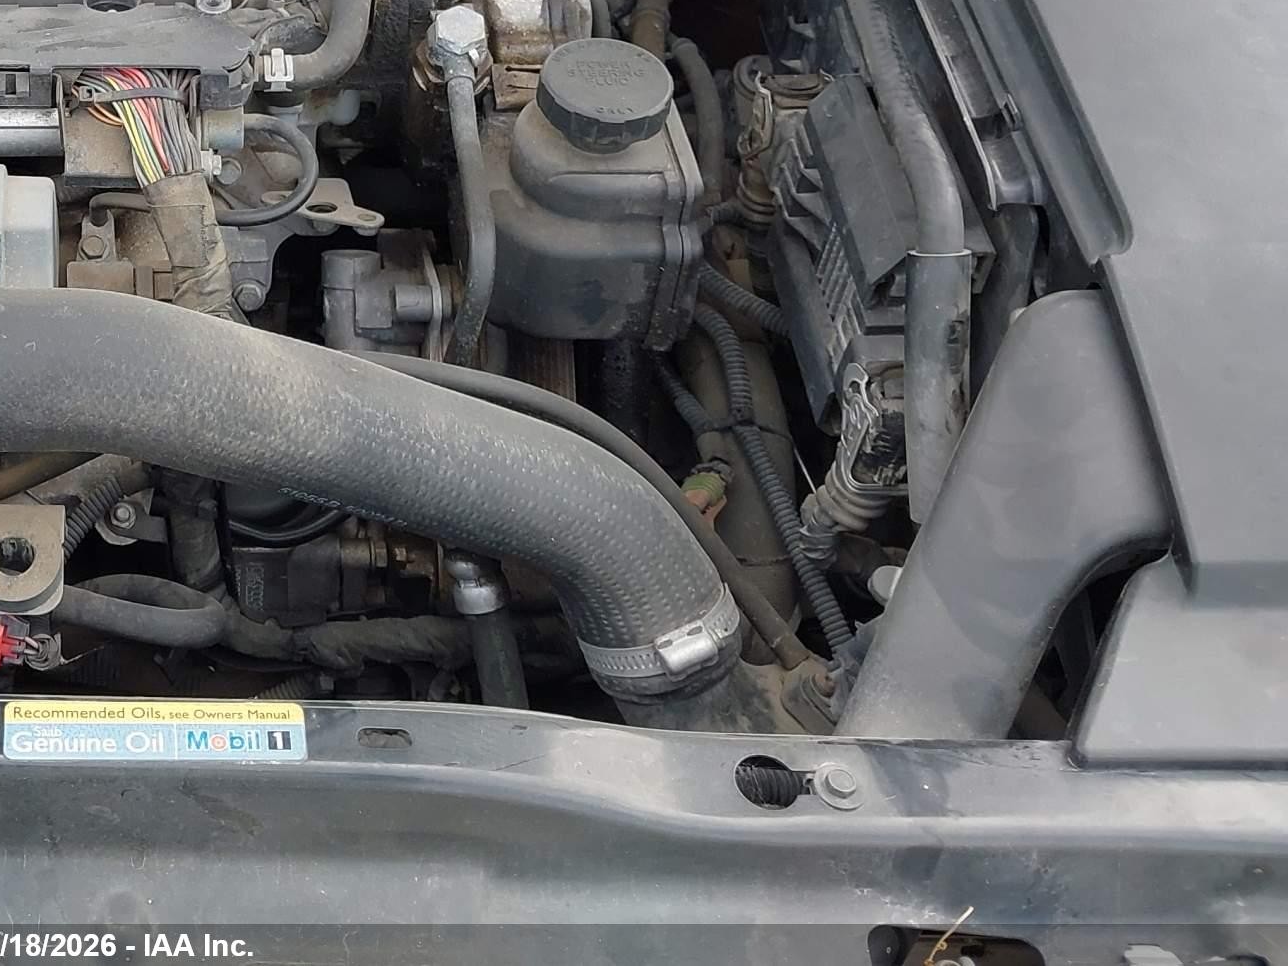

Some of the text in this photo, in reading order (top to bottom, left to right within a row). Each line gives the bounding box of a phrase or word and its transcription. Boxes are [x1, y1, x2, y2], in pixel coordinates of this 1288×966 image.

[13, 706, 291, 720] Recommended Oils, see Owners Manual
[33, 726, 63, 738] Saab
[187, 730, 261, 751] Mobil
[11, 731, 164, 753] Genuine Oil
